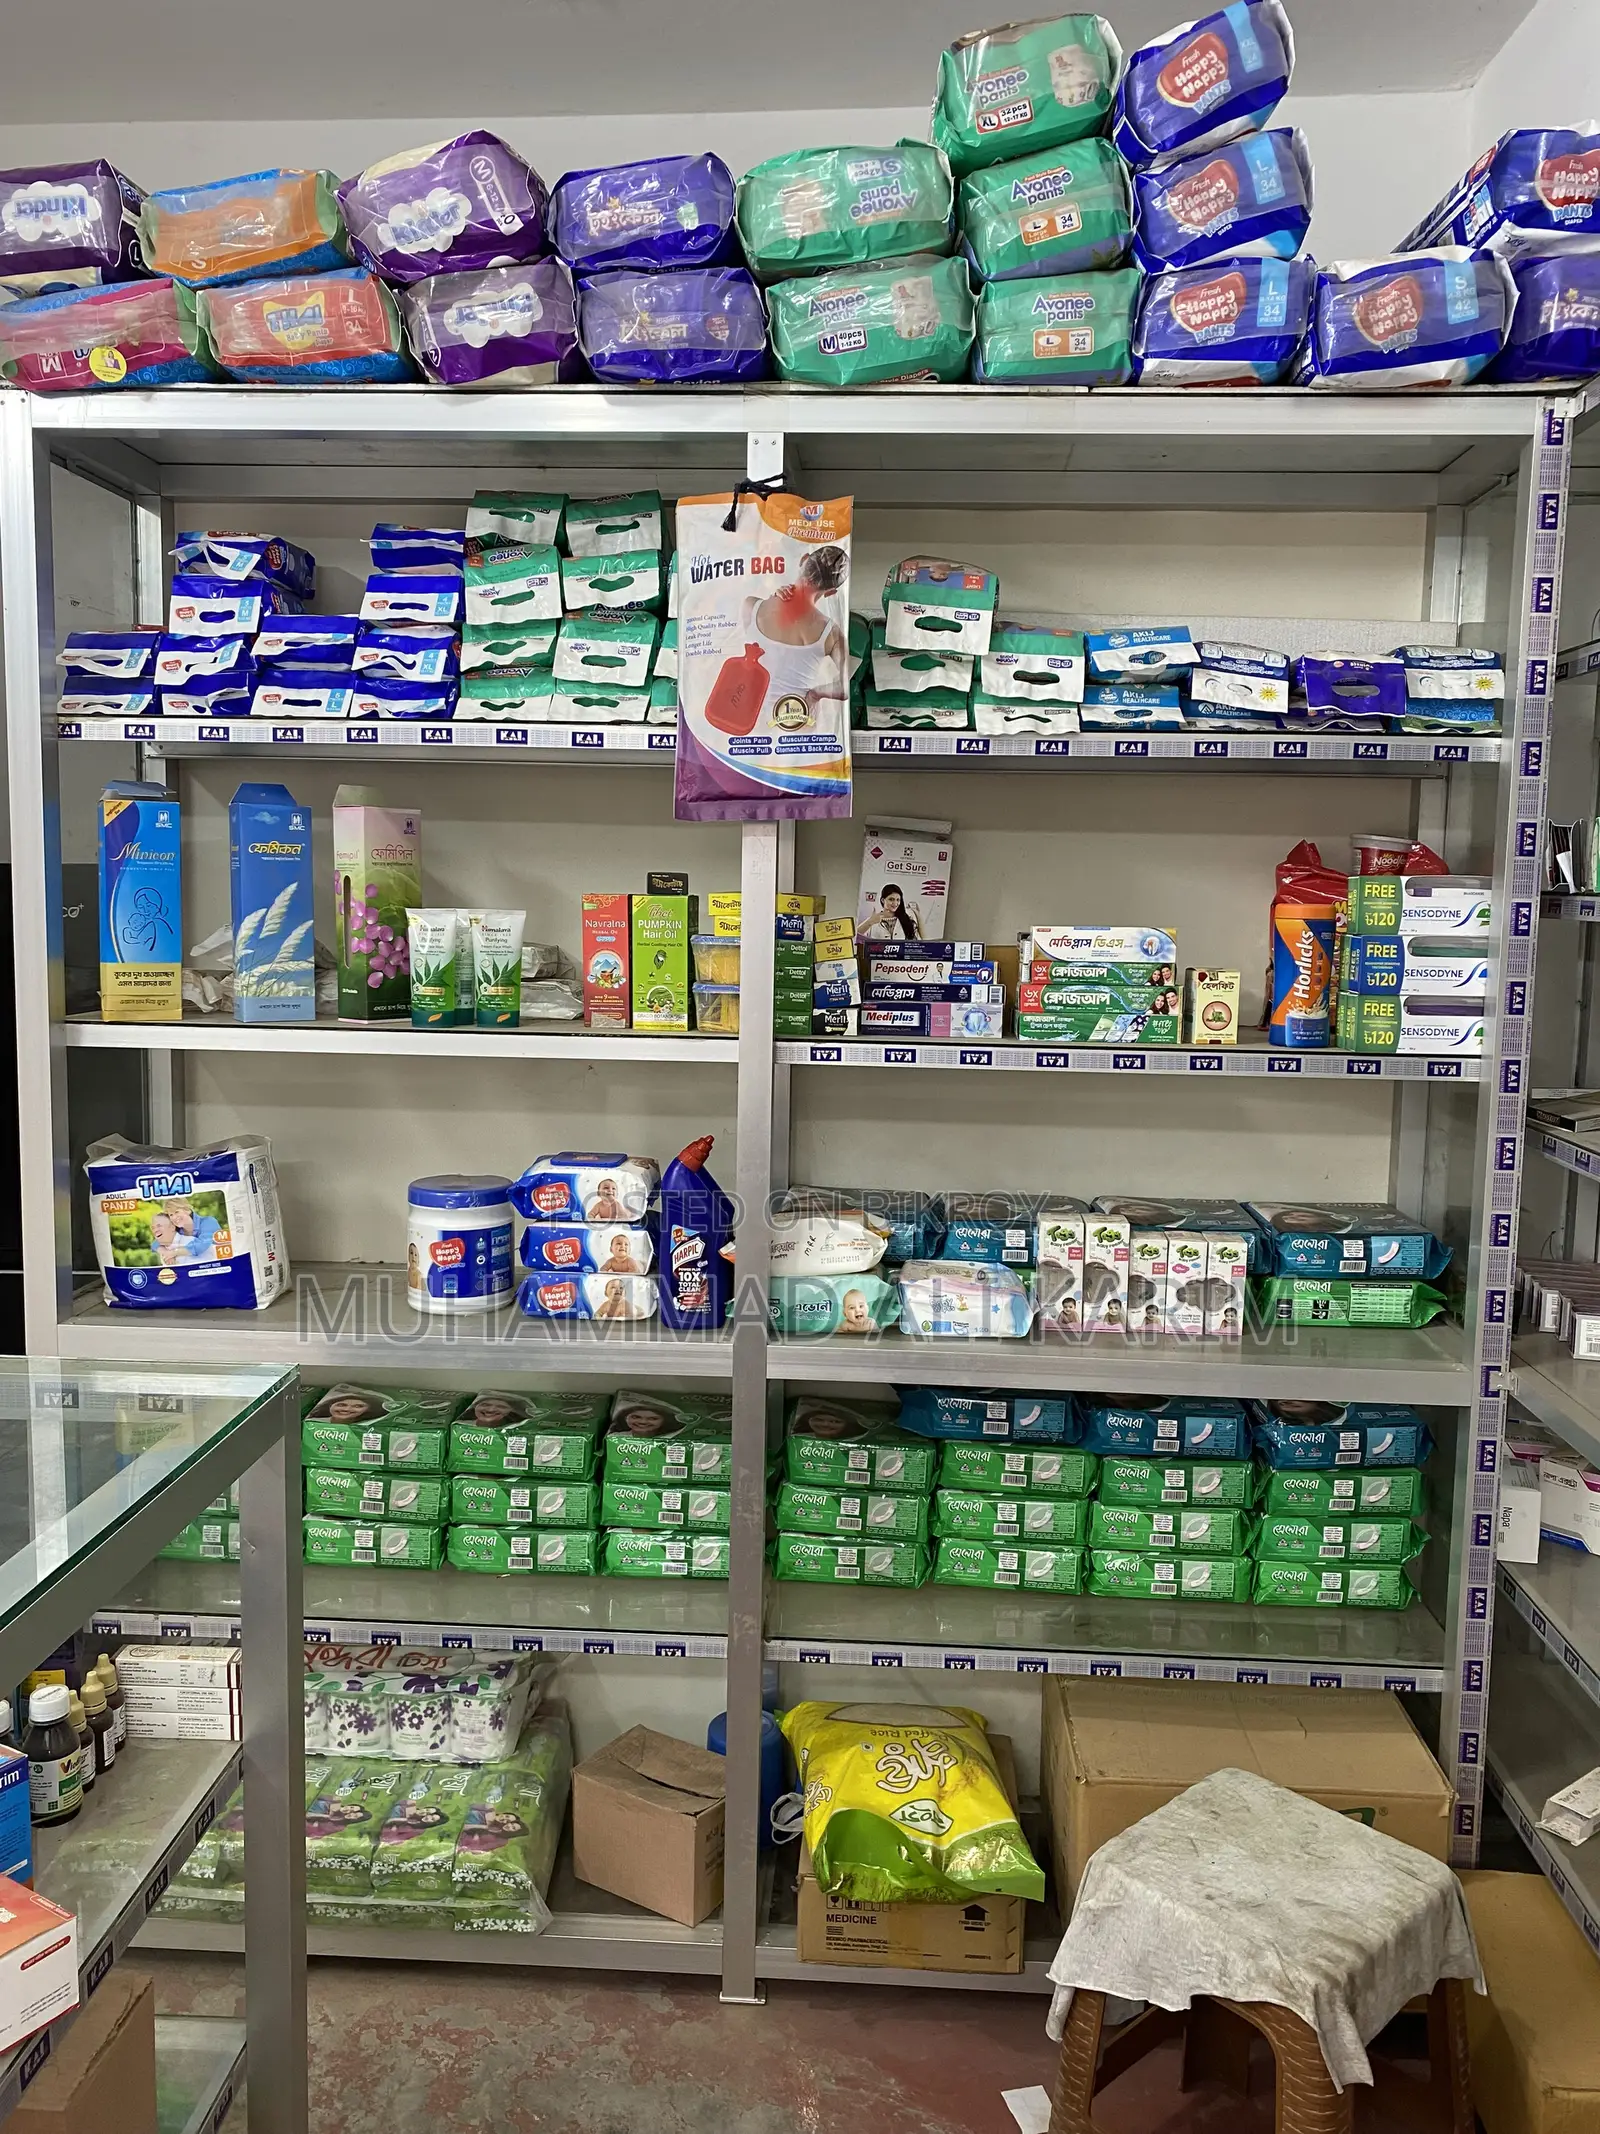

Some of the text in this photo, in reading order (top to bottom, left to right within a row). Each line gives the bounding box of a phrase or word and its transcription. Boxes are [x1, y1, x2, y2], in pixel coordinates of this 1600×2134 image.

[1175, 49, 1218, 86] Happy
[1183, 62, 1227, 98] Nappy
[1000, 102, 1028, 118] 32pcs
[980, 114, 997, 128] XL
[474, 161, 493, 180] M
[1553, 168, 1599, 185] Happy
[1012, 171, 1073, 200] Avonee
[1260, 177, 1277, 191] 34
[860, 181, 900, 201] pants
[1028, 187, 1064, 207] pants
[1552, 183, 1599, 200] Nappy
[850, 190, 918, 218] Avonee
[1061, 214, 1073, 225] 34
[1553, 203, 1593, 223] PANTS
[1268, 284, 1278, 296] L
[808, 293, 869, 317] Avonee
[1033, 297, 1095, 313] Avonee
[1184, 289, 1236, 314] Happy
[1369, 294, 1412, 321] Happy
[1047, 307, 1085, 323] pants
[1263, 304, 1280, 316] 34
[1372, 308, 1418, 335] Nappy
[822, 336, 836, 349] M
[1074, 337, 1087, 347] 34
[788, 518, 835, 528] MEDI USE
[787, 526, 836, 540] Premium
[691, 553, 711, 565] Hot
[690, 557, 785, 584] WATER BAG
[1540, 583, 1552, 607] KAI
[1132, 630, 1155, 638] AKIJ
[1133, 635, 1172, 643] HEALTHCARE
[1122, 690, 1144, 699] AKIJ
[128, 727, 154, 737] KAI
[202, 729, 224, 739] KAI
[350, 730, 373, 740] KAI
[500, 731, 523, 742] KAI
[575, 734, 598, 745] KAI
[811, 735, 836, 743] Cramps
[960, 741, 984, 751] KAI
[1119, 744, 1143, 754] KAI
[1199, 744, 1222, 754] KAI
[1358, 746, 1382, 756] KAI
[1528, 747, 1540, 770] KAI
[110, 841, 176, 861] Minicon
[248, 841, 303, 857] ফেমিকন
[371, 843, 415, 861] ফেমিপিল
[887, 860, 928, 872] Get Sure
[1364, 884, 1396, 898] FREE
[647, 904, 673, 918] Tibet
[1402, 909, 1462, 919] SENSODYNE
[638, 920, 682, 929] PUMPKIN
[781, 920, 803, 930] Meril
[1518, 908, 1530, 930] KAI
[643, 930, 677, 939] Hair Oil
[790, 944, 808, 952] Dettol
[1048, 934, 1125, 950] মেডিপ্লাস ডিএস
[1366, 944, 1398, 959] FREE
[875, 961, 930, 974] Pepsodent
[1293, 929, 1315, 999] Horlicks
[1051, 966, 1108, 978] ক্লোজআপ
[1404, 968, 1464, 978] SENSODYNE
[826, 984, 849, 995] Meril
[871, 985, 916, 999] মেডিপ্লাস
[1201, 980, 1236, 991] হেলফিট
[790, 991, 807, 999] Dettol
[1043, 991, 1111, 1006] ক্লোজআপ
[1512, 987, 1524, 1009] KAI
[1363, 1002, 1395, 1017] FREE
[824, 1015, 847, 1024] Meril
[865, 1011, 915, 1024] Mediplus
[1400, 1027, 1460, 1037] SENSODYNE
[816, 1050, 838, 1060] KAI
[965, 1054, 988, 1063] KAI
[1042, 1056, 1065, 1066] KAI
[1196, 1059, 1218, 1069] KAI
[1353, 1063, 1376, 1073] KAI
[1433, 1065, 1457, 1075] KAI
[1502, 1143, 1514, 1164] KAI
[138, 1175, 193, 1198] THAI
[105, 1192, 127, 1200] ADULT
[538, 1190, 564, 1201] Happy
[102, 1200, 136, 1212] PANTS
[540, 1197, 567, 1208] Nappy
[216, 1231, 228, 1241] M
[955, 1226, 992, 1240] সেনোরা
[218, 1246, 231, 1256] 10
[1291, 1239, 1329, 1250] সেনোরা
[434, 1246, 460, 1259] Happy
[437, 1252, 462, 1262] Nappy
[673, 1242, 700, 1264] HARPIC
[679, 1272, 700, 1282] 10X
[1293, 1280, 1333, 1293] সেনোরা
[544, 1290, 571, 1301] Happy
[546, 1296, 573, 1308] Nappy
[794, 1299, 832, 1314] এভোনী
[1493, 1296, 1504, 1317] KAI
[937, 1397, 973, 1411] সেনোরা
[1106, 1416, 1145, 1430] সেনোরা
[314, 1430, 349, 1442] সেনোরা
[459, 1432, 493, 1445] সেনোরা
[1288, 1432, 1327, 1446] সেনোরা
[616, 1442, 652, 1455] সেনোরা
[799, 1446, 835, 1459] সেনোরা
[1484, 1446, 1495, 1466] KAI
[316, 1477, 351, 1489] সেনোরা
[1282, 1478, 1320, 1491] সেনোরা
[462, 1486, 497, 1499] সেনোরা
[791, 1493, 827, 1507] সেনোরা
[947, 1500, 983, 1514] সেনোরা
[1102, 1511, 1139, 1524] সেনোরা
[1502, 1506, 1513, 1528] Napa
[1272, 1524, 1309, 1536] সেনোরা
[462, 1535, 497, 1547] সেনোরা
[616, 1539, 652, 1552] সেনোরা
[789, 1545, 824, 1557] সেনোরা
[949, 1546, 984, 1560] সেনোরা
[1104, 1560, 1141, 1574] সেনোরা
[1474, 1593, 1485, 1613] KAI
[870, 1729, 900, 1738] Rice
[1466, 1738, 1475, 1758] KAI
[876, 1739, 959, 1794] মুড়ি
[825, 1913, 878, 1925] MEDICINE
